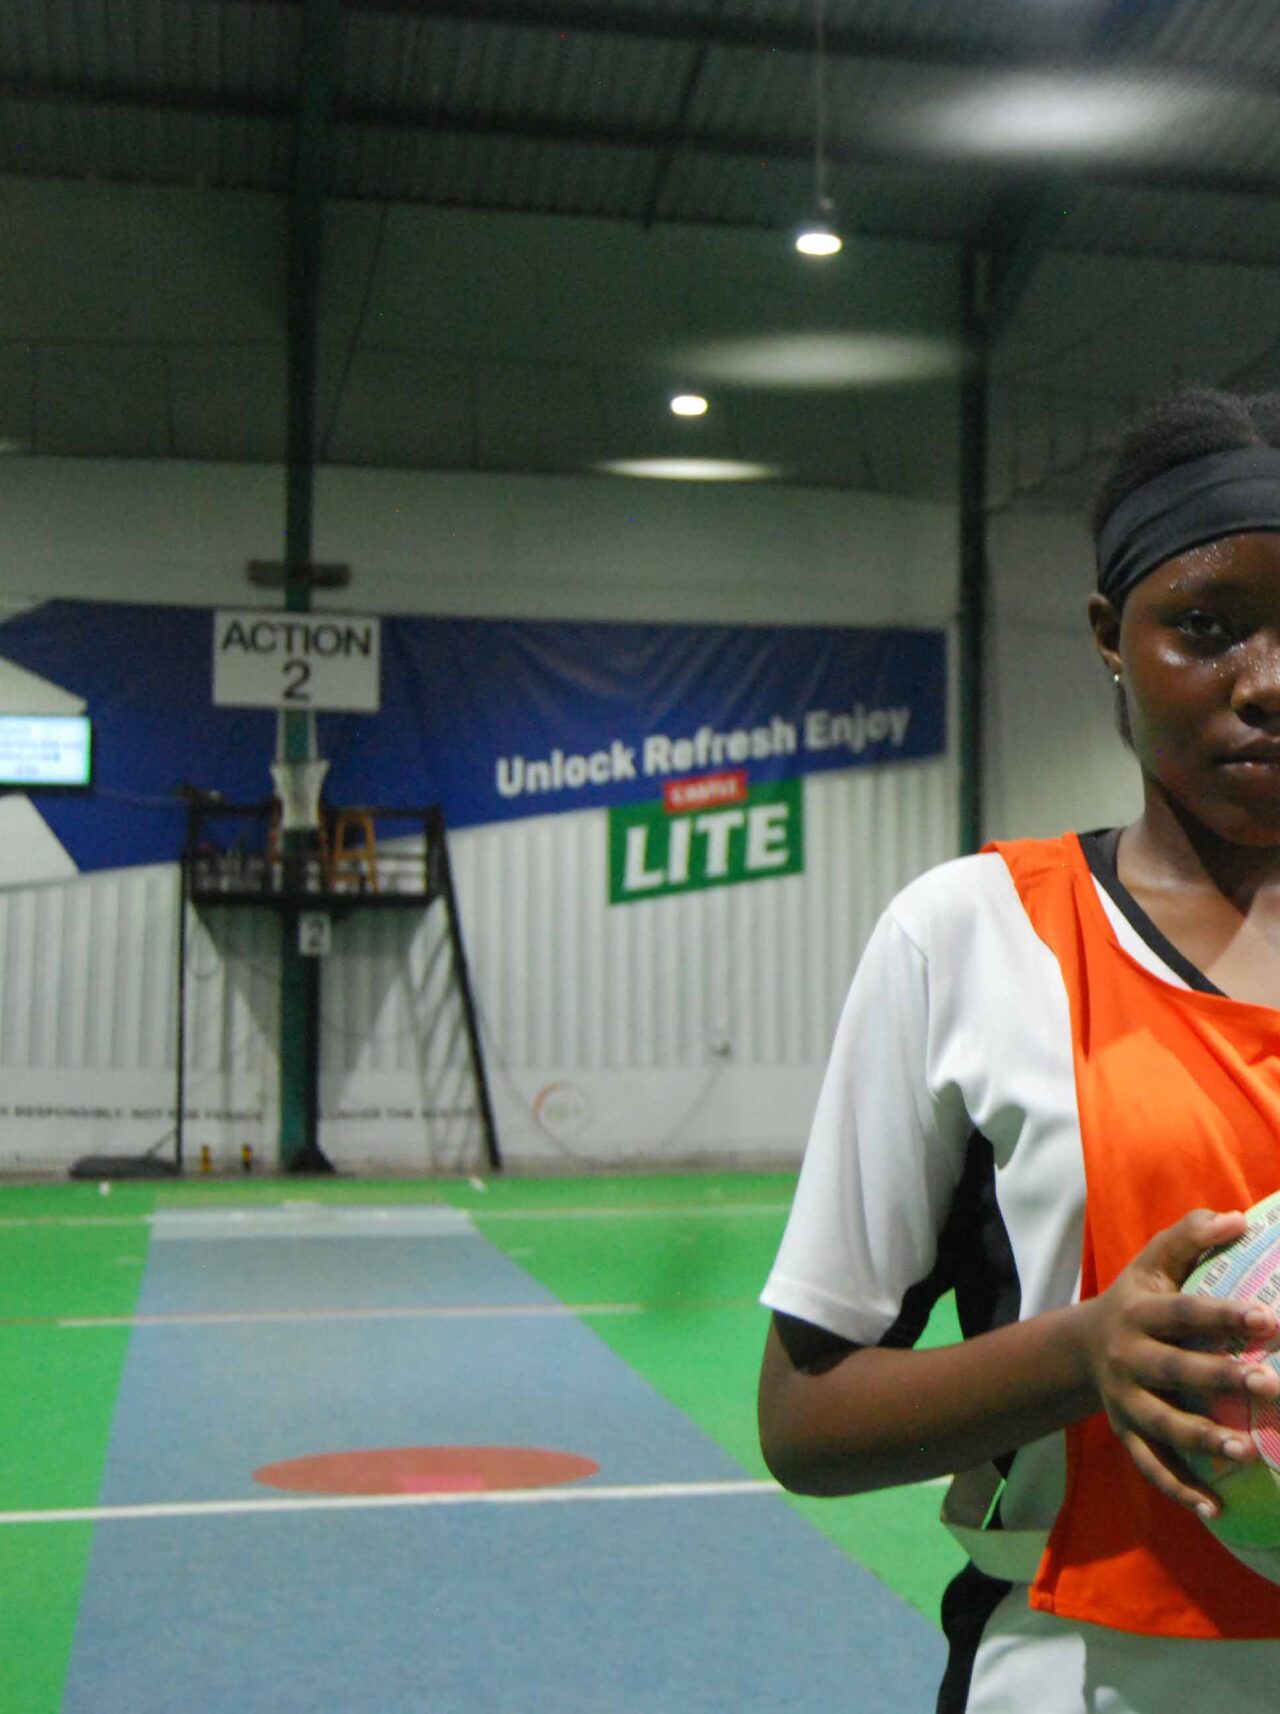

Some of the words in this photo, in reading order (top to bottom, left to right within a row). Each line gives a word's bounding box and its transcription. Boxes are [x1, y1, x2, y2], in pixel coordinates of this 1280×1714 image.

[221, 620, 374, 657] ACTION
[282, 659, 312, 701] 2
[496, 742, 637, 798] Unlock
[643, 717, 796, 776] Refresh
[804, 705, 912, 754] Enjoy
[622, 804, 791, 892] LITE
